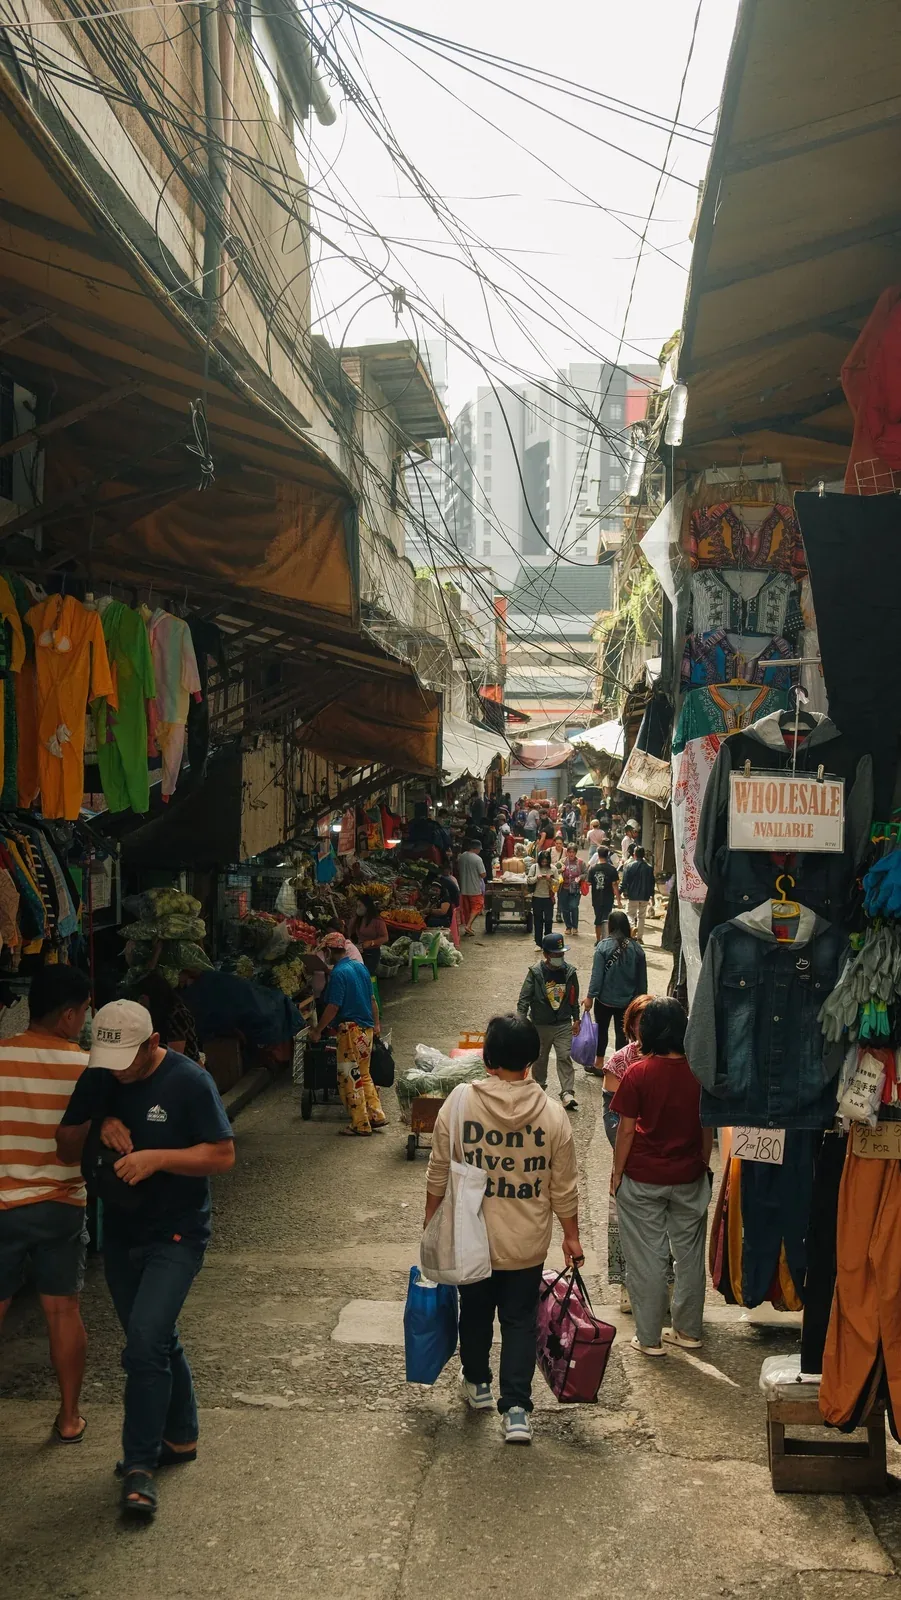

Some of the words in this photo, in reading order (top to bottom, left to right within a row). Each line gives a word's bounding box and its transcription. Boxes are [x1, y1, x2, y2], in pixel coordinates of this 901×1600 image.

[734, 781, 840, 817] WHOLESALE
[753, 822, 814, 838] AVAILABLE
[97, 1029, 121, 1040] FIRE
[463, 1120, 546, 1148] Don't
[859, 1137, 868, 1153] 2
[873, 1143, 890, 1153] FOR
[734, 1133, 749, 1157] 2
[753, 1136, 782, 1161] 180
[484, 1176, 542, 1199] that
